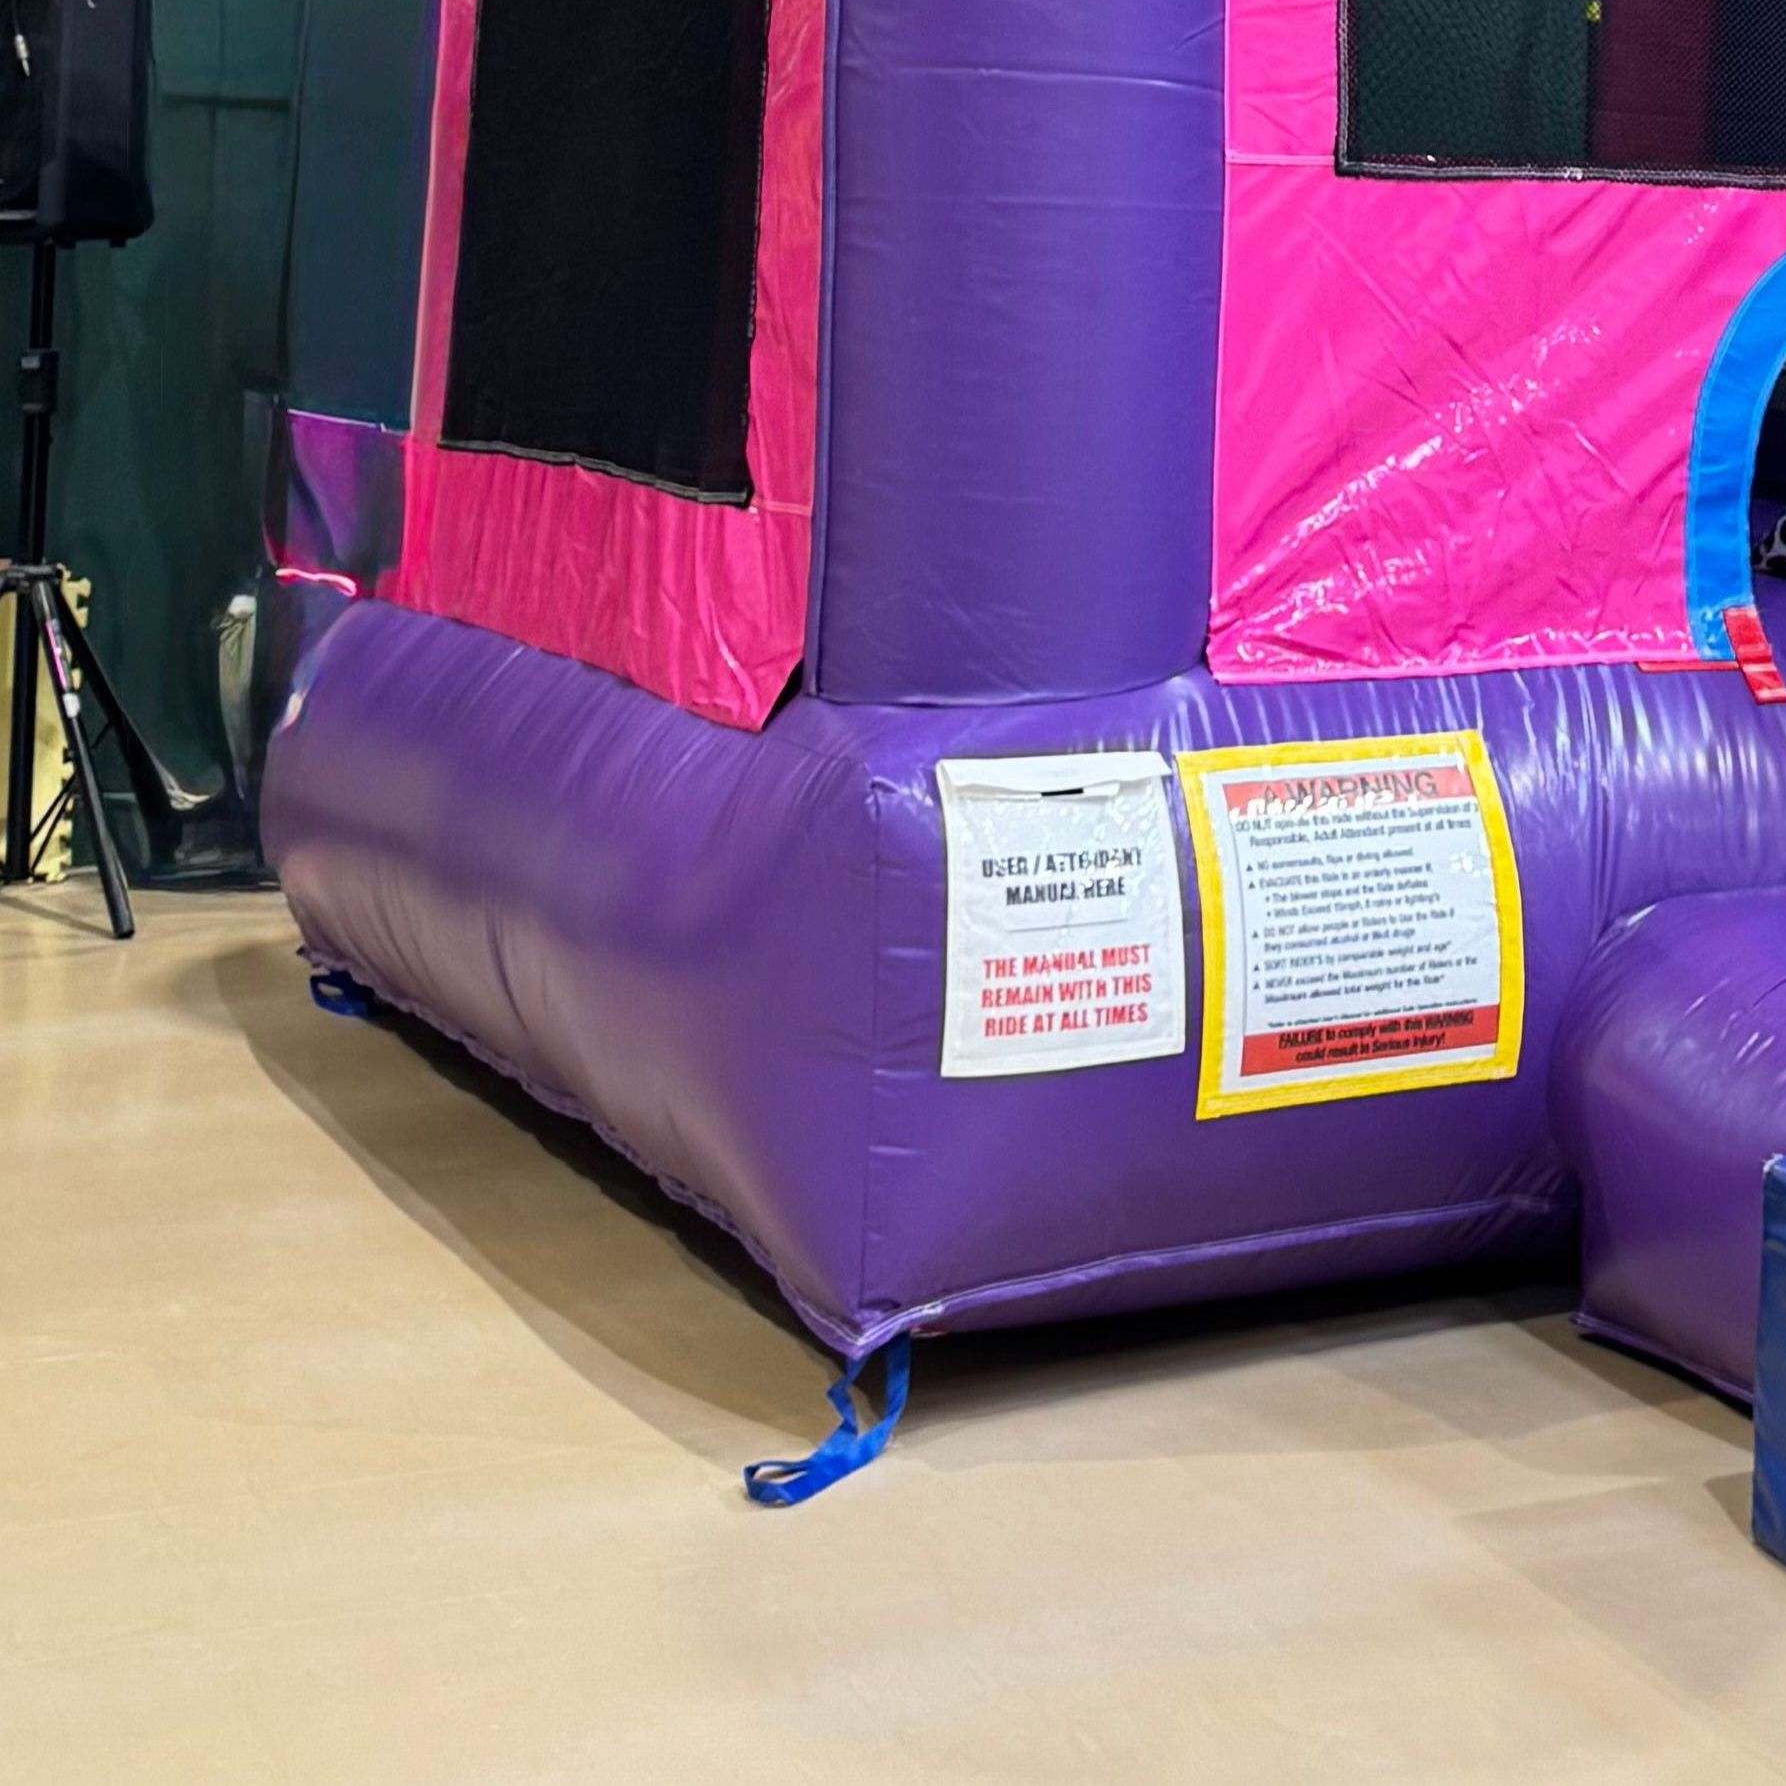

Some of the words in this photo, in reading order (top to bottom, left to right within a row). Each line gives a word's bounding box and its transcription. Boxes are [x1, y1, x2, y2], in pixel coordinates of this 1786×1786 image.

[1284, 771, 1437, 811] WARNING
[981, 857, 1028, 878] USER
[1006, 880, 1079, 906] MANUAL
[1083, 876, 1126, 899] HERE
[983, 957, 1017, 979] THE
[1022, 948, 1097, 975] MANUAL
[1101, 943, 1151, 968] MUST
[981, 983, 1054, 1009] REMAIN
[1058, 979, 1107, 1001] WITH
[1112, 973, 1152, 996] THIS
[984, 1015, 1028, 1038] RIDE
[1033, 1012, 1055, 1033] AT
[1060, 1008, 1090, 1031] ALL
[1094, 1003, 1148, 1027] TIMES
